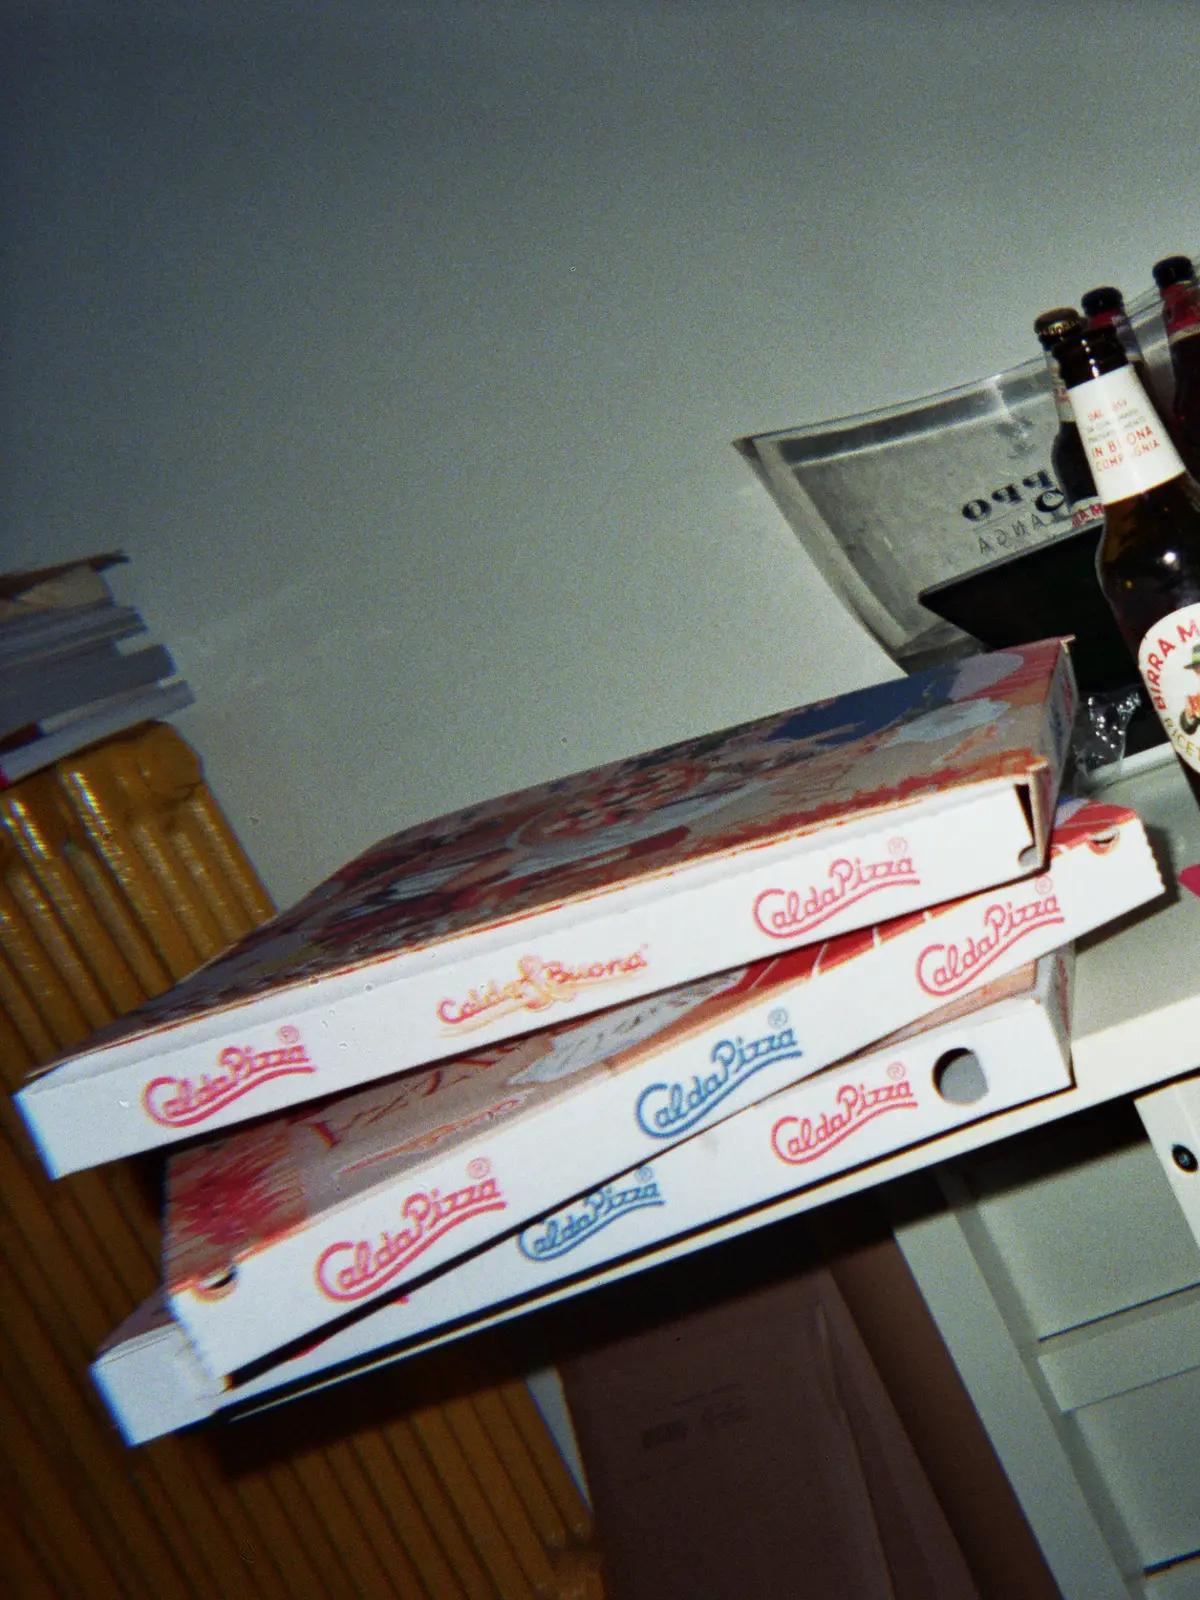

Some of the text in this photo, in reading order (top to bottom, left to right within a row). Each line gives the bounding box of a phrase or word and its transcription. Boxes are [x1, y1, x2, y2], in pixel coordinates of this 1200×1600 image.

[1095, 439, 1161, 474] COMPGNIA
[1107, 426, 1155, 455] BONA
[1146, 637, 1177, 712] BIRRA
